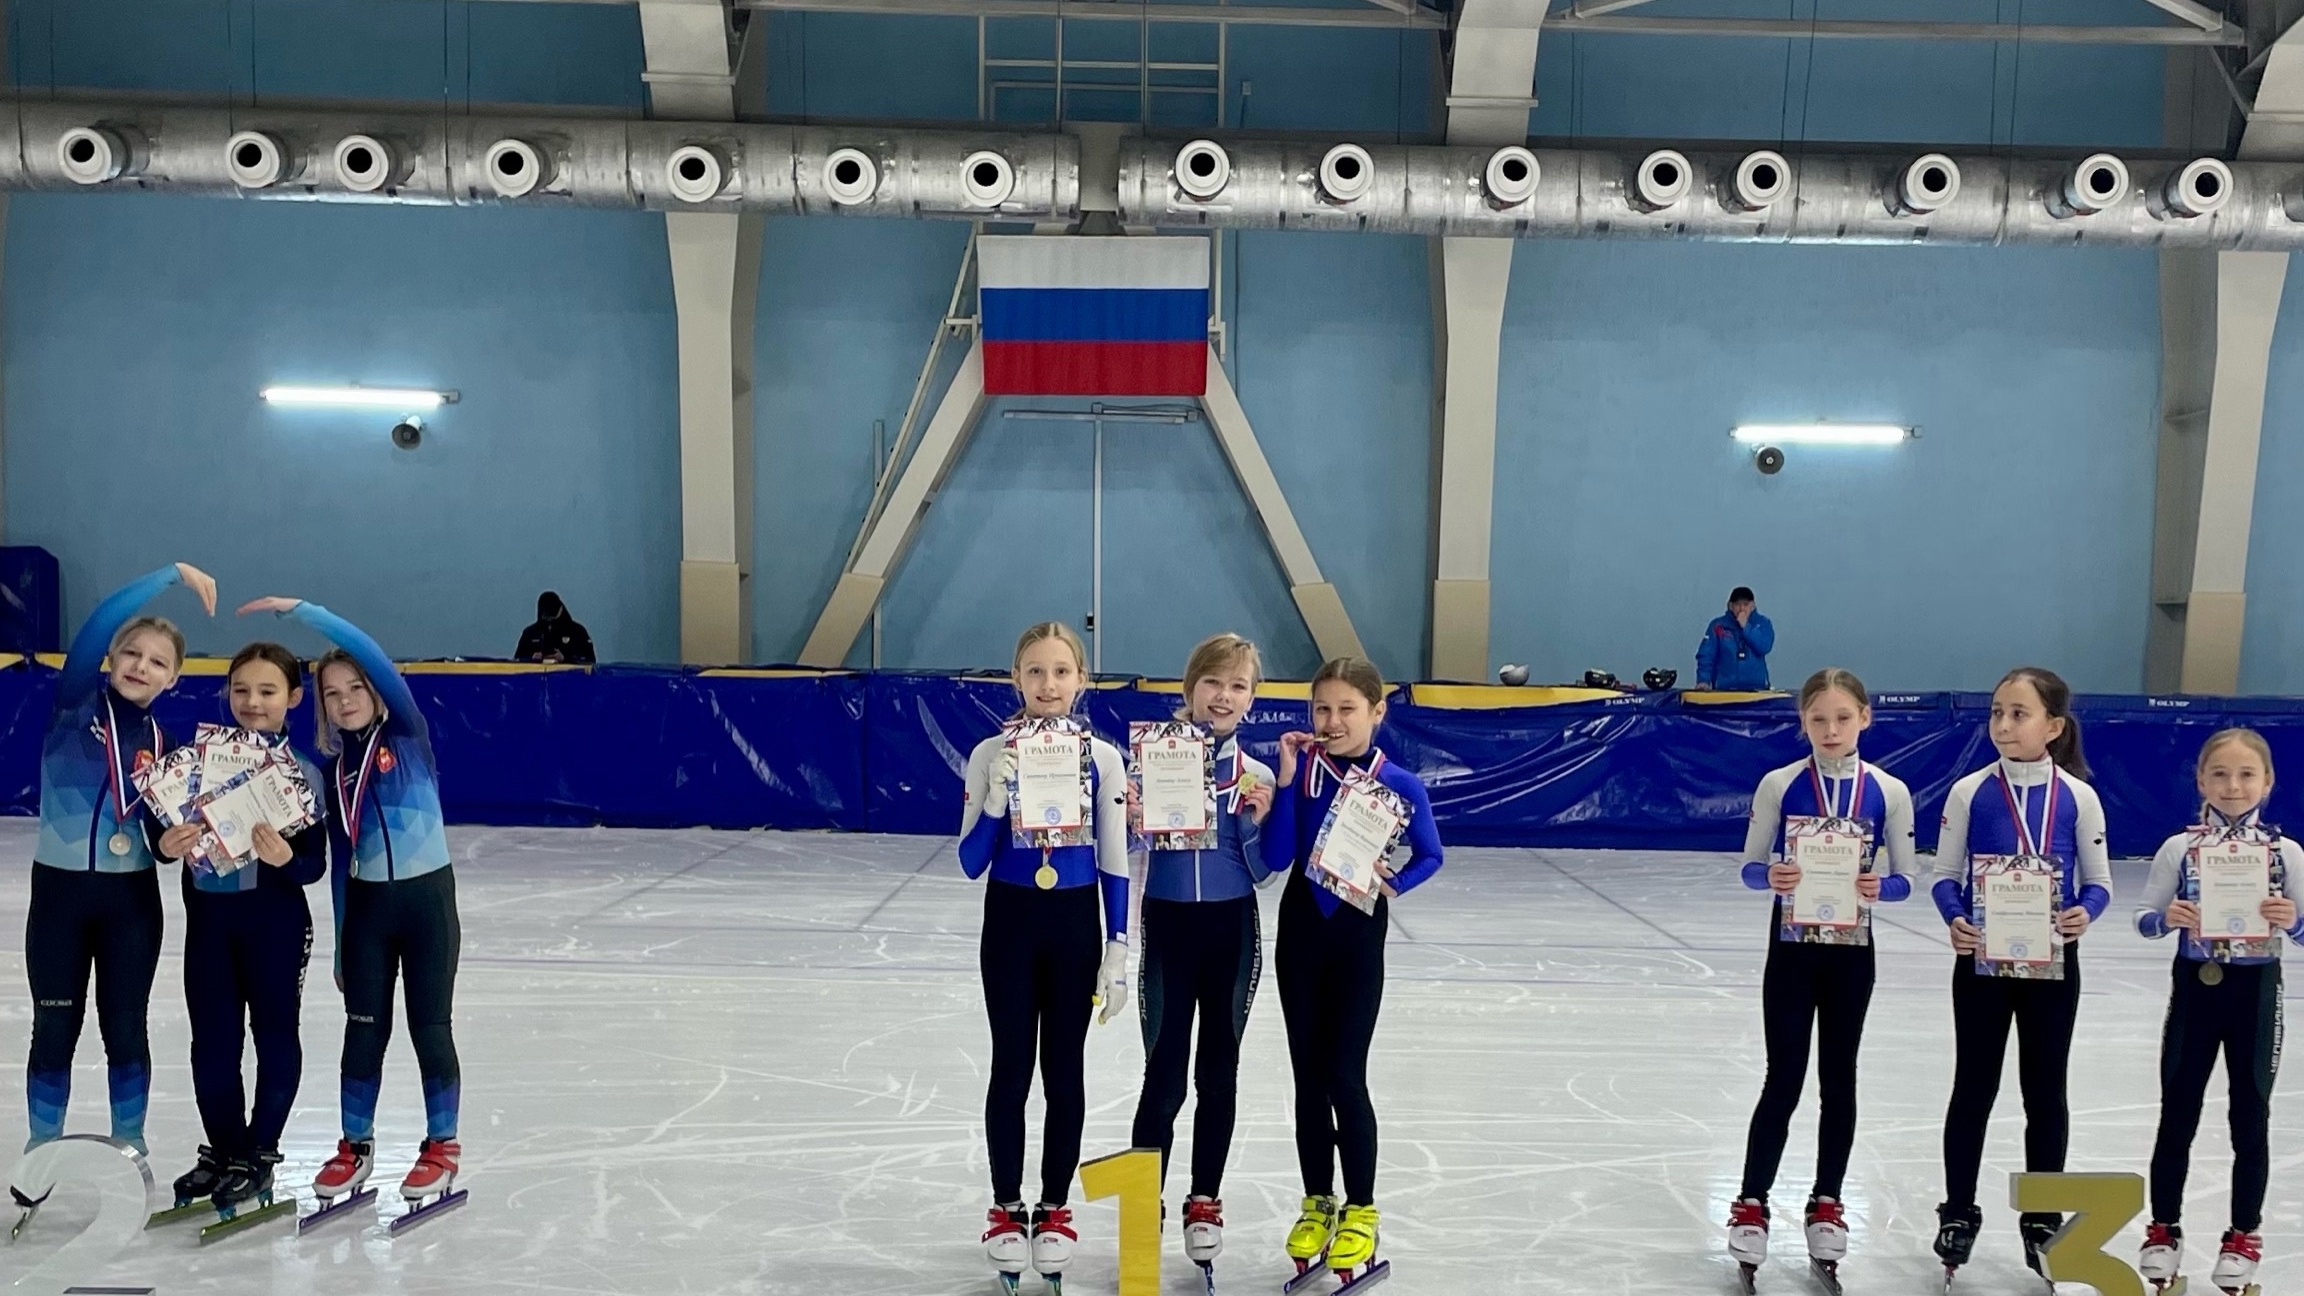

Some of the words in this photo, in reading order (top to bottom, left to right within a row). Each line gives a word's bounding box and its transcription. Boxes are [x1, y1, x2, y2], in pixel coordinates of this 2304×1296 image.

[1886, 695, 1920, 703] OLYMP
[1024, 745, 1074, 756] ГРАМОТА
[1148, 751, 1197, 760] ГРАМОТА
[264, 774, 293, 818] ГРАМОТА
[1349, 798, 1388, 831] ГРАМОТА
[1803, 845, 1854, 855] ГРАМОТА
[2207, 855, 2262, 865] ГРАМОТА
[1992, 884, 2044, 893] ГРАМОТА
[1243, 909, 1260, 1014] ЧЕЛЯБИНСК
[1079, 1147, 1162, 1296] 1
[2009, 1171, 2146, 1296] 3
